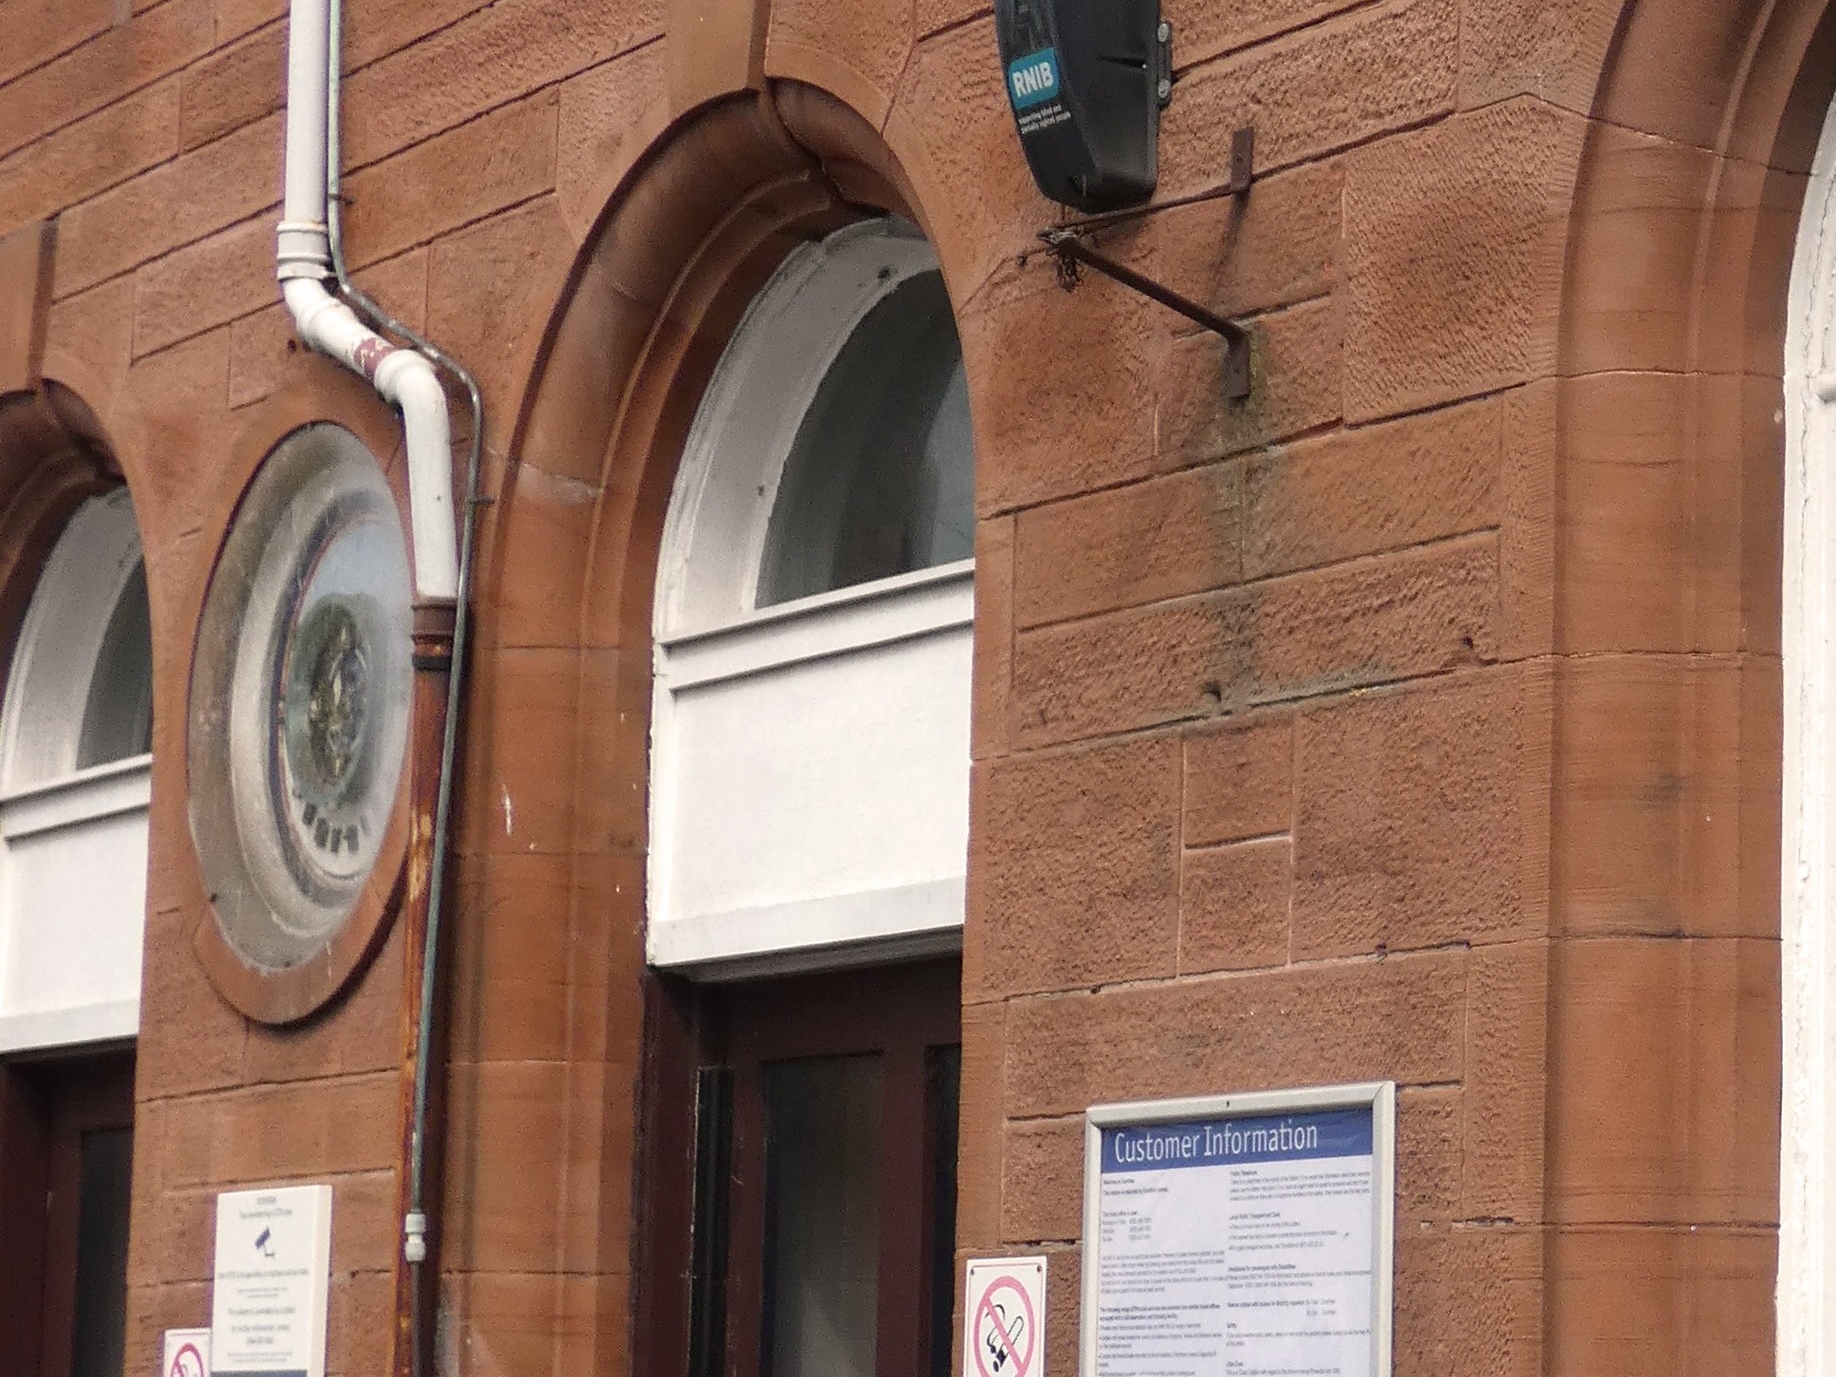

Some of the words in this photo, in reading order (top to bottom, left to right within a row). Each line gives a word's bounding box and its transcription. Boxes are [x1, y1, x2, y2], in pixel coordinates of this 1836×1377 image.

[1012, 61, 1054, 98] RNIB
[1114, 1130, 1200, 1164] Customer
[1203, 1118, 1318, 1157] Information
